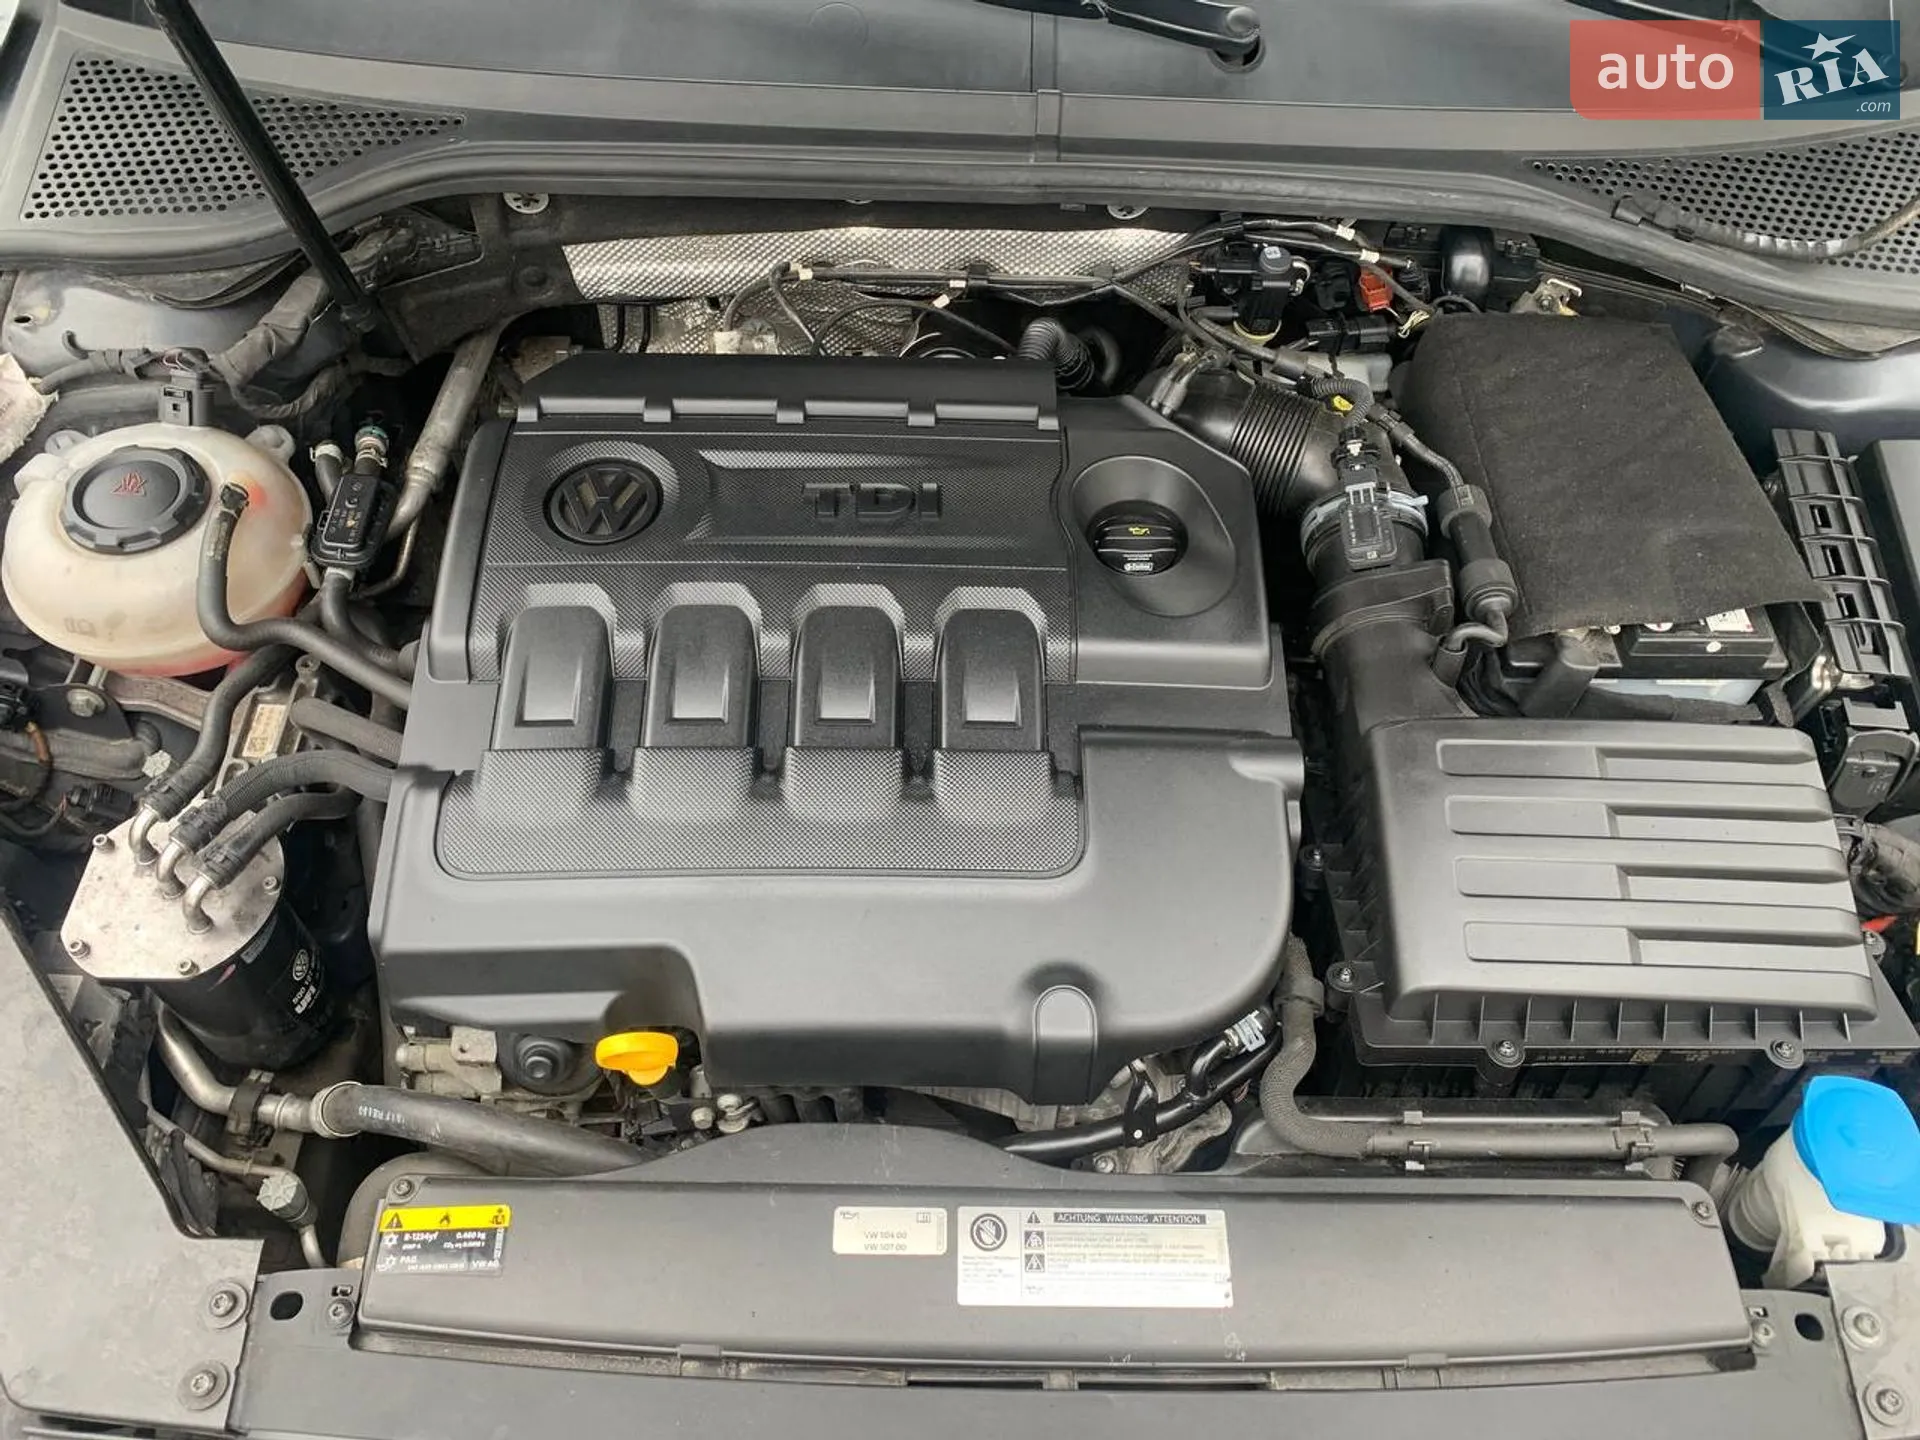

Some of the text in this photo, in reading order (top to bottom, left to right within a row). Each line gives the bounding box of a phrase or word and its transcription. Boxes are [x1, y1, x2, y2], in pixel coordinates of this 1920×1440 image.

[802, 482, 942, 519] TDI
[1057, 1213, 1201, 1224] ACHTUNG WARNING ATTENTION
[863, 1231, 878, 1239] VW
[895, 1231, 908, 1239] 00
[863, 1243, 878, 1251] VW
[895, 1243, 908, 1251] 00
